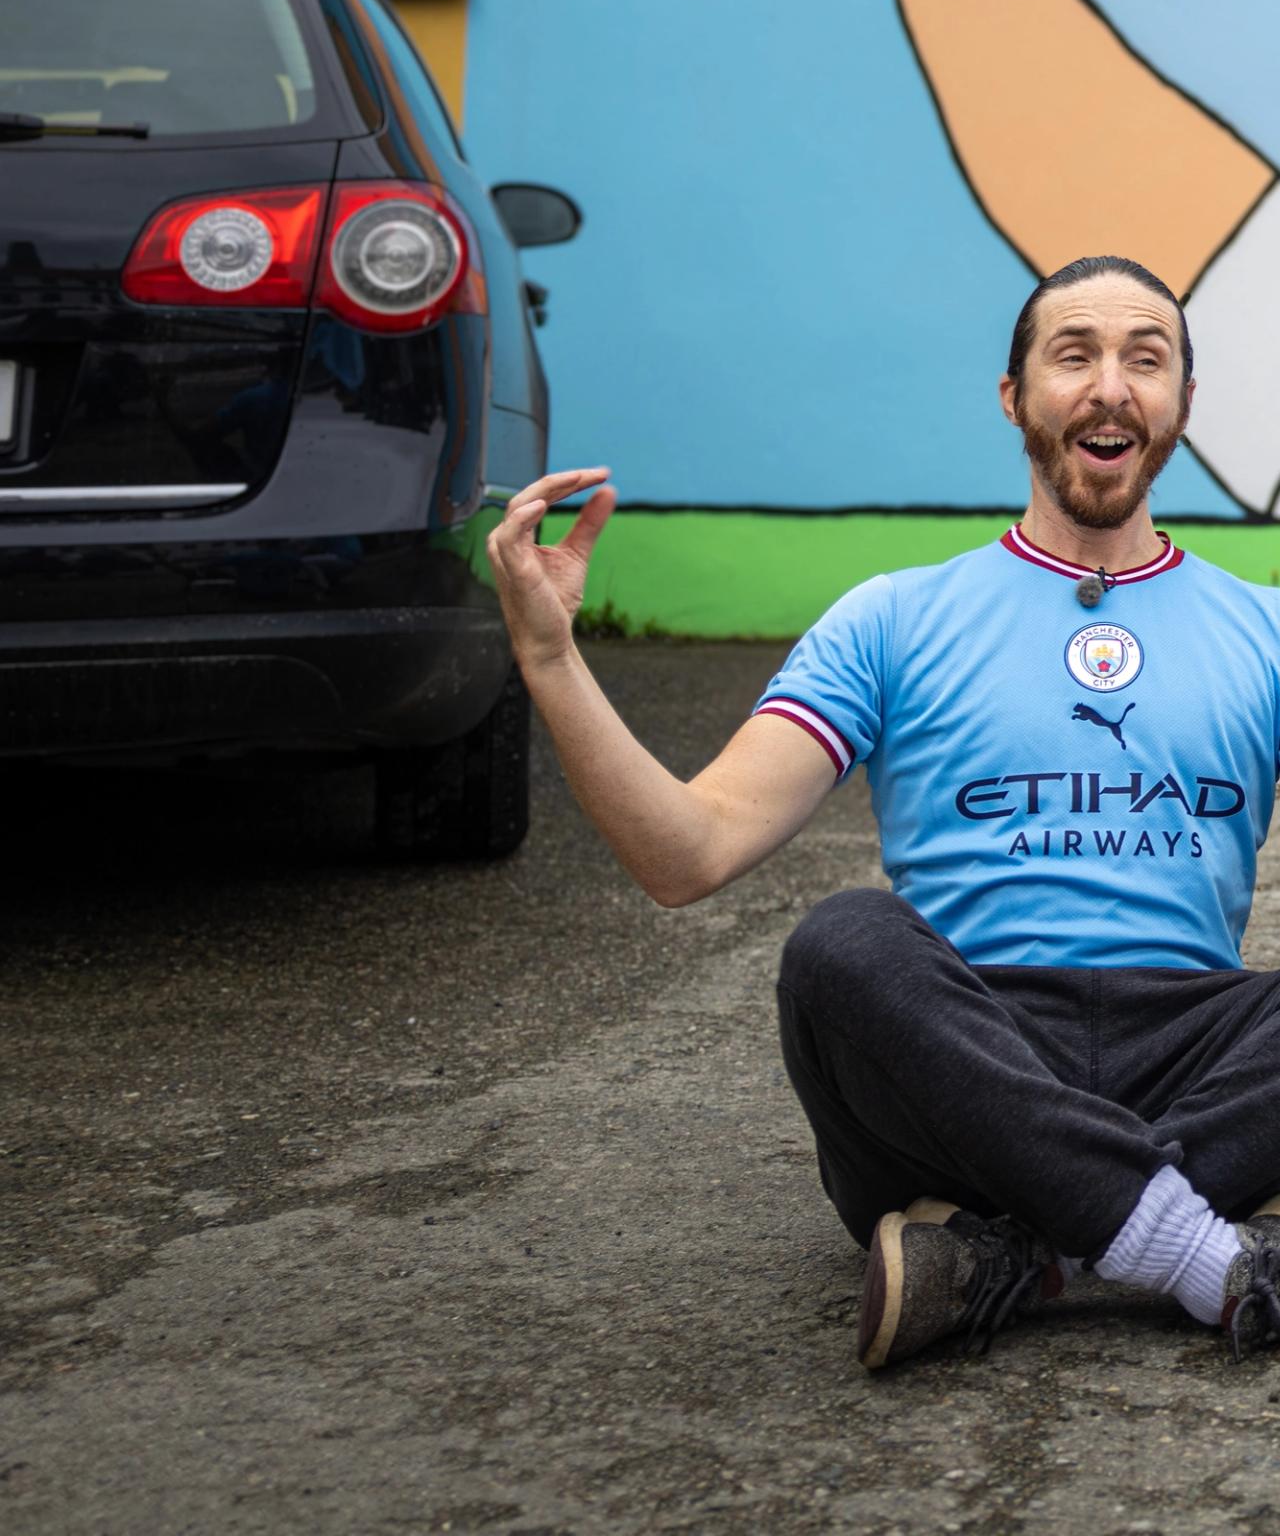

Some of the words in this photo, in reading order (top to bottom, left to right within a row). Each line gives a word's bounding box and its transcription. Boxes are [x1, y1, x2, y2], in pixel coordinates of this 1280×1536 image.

[1074, 628, 1134, 648] MANCHESTER
[1093, 679, 1115, 687] CITY
[955, 772, 1246, 820] ETIHAD
[1008, 830, 1203, 858] AIRWAYS
